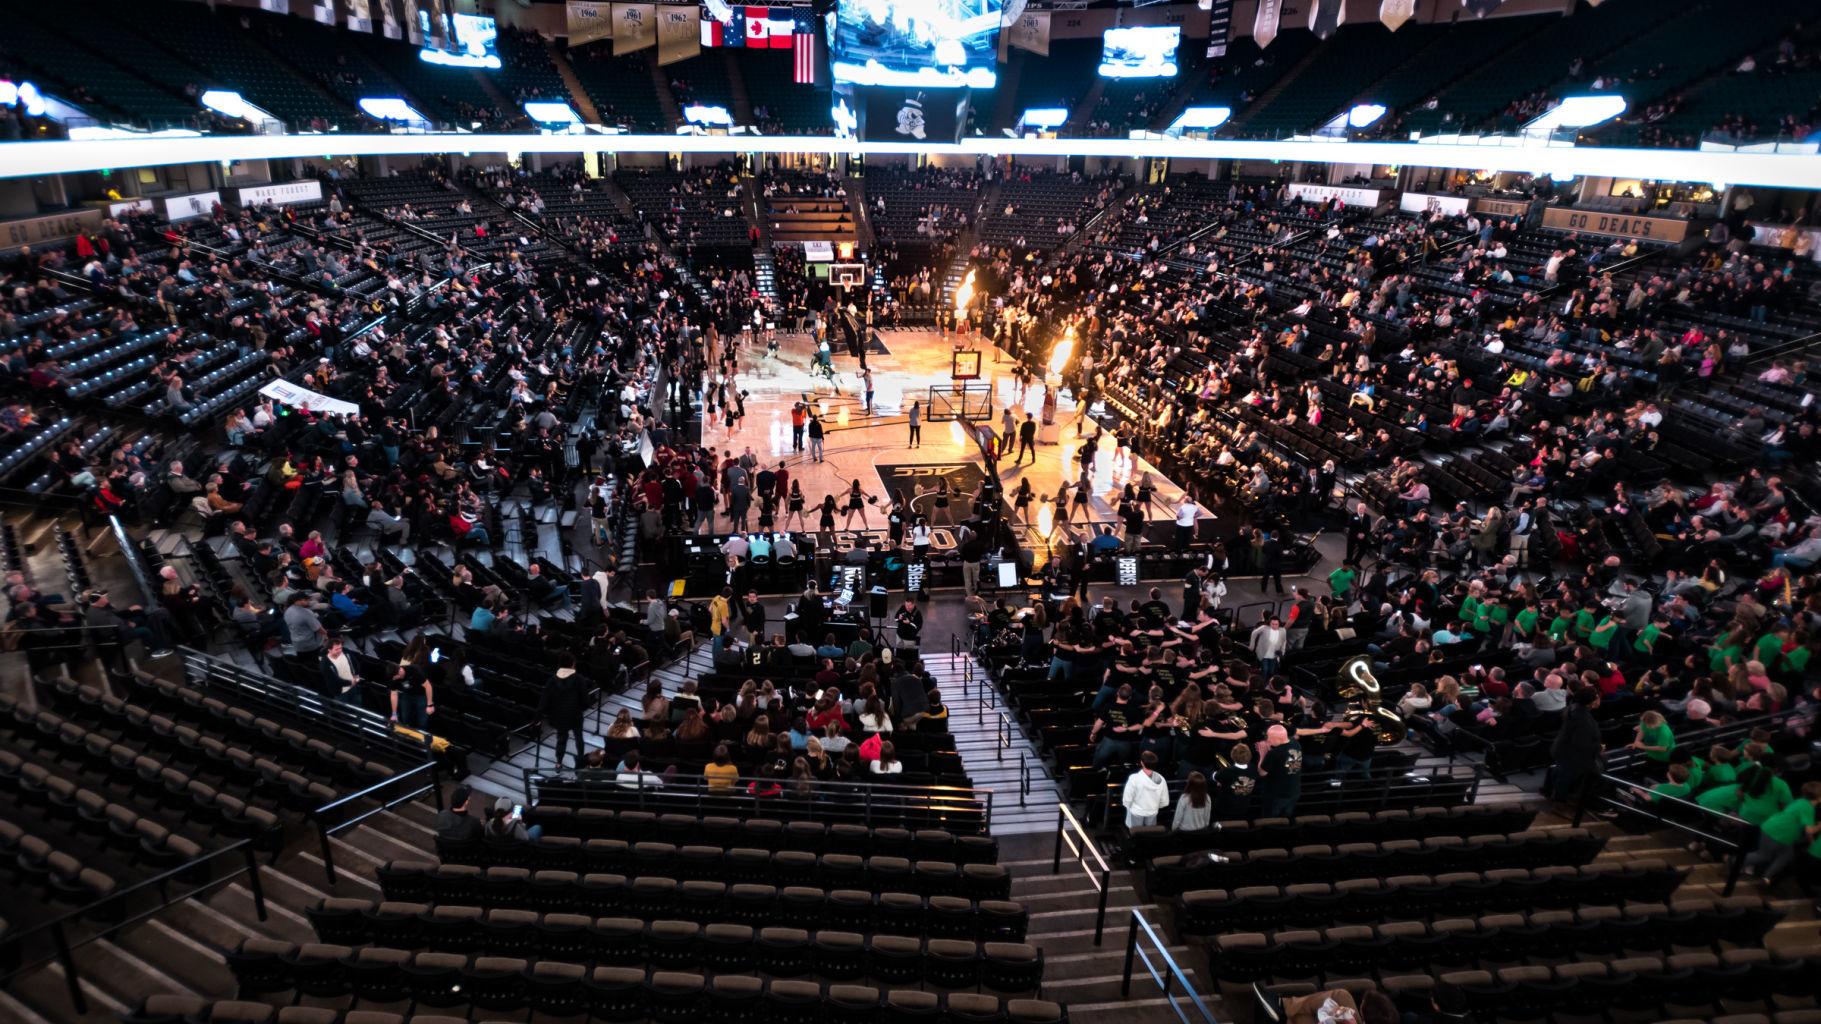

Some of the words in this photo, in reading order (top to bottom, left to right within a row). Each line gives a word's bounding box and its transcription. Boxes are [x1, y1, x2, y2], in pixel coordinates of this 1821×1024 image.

[581, 9, 597, 17] 1960
[626, 11, 642, 20] 1961
[670, 14, 687, 22] 1962
[1569, 213, 1587, 229] GO
[1599, 216, 1652, 236] DEACS
